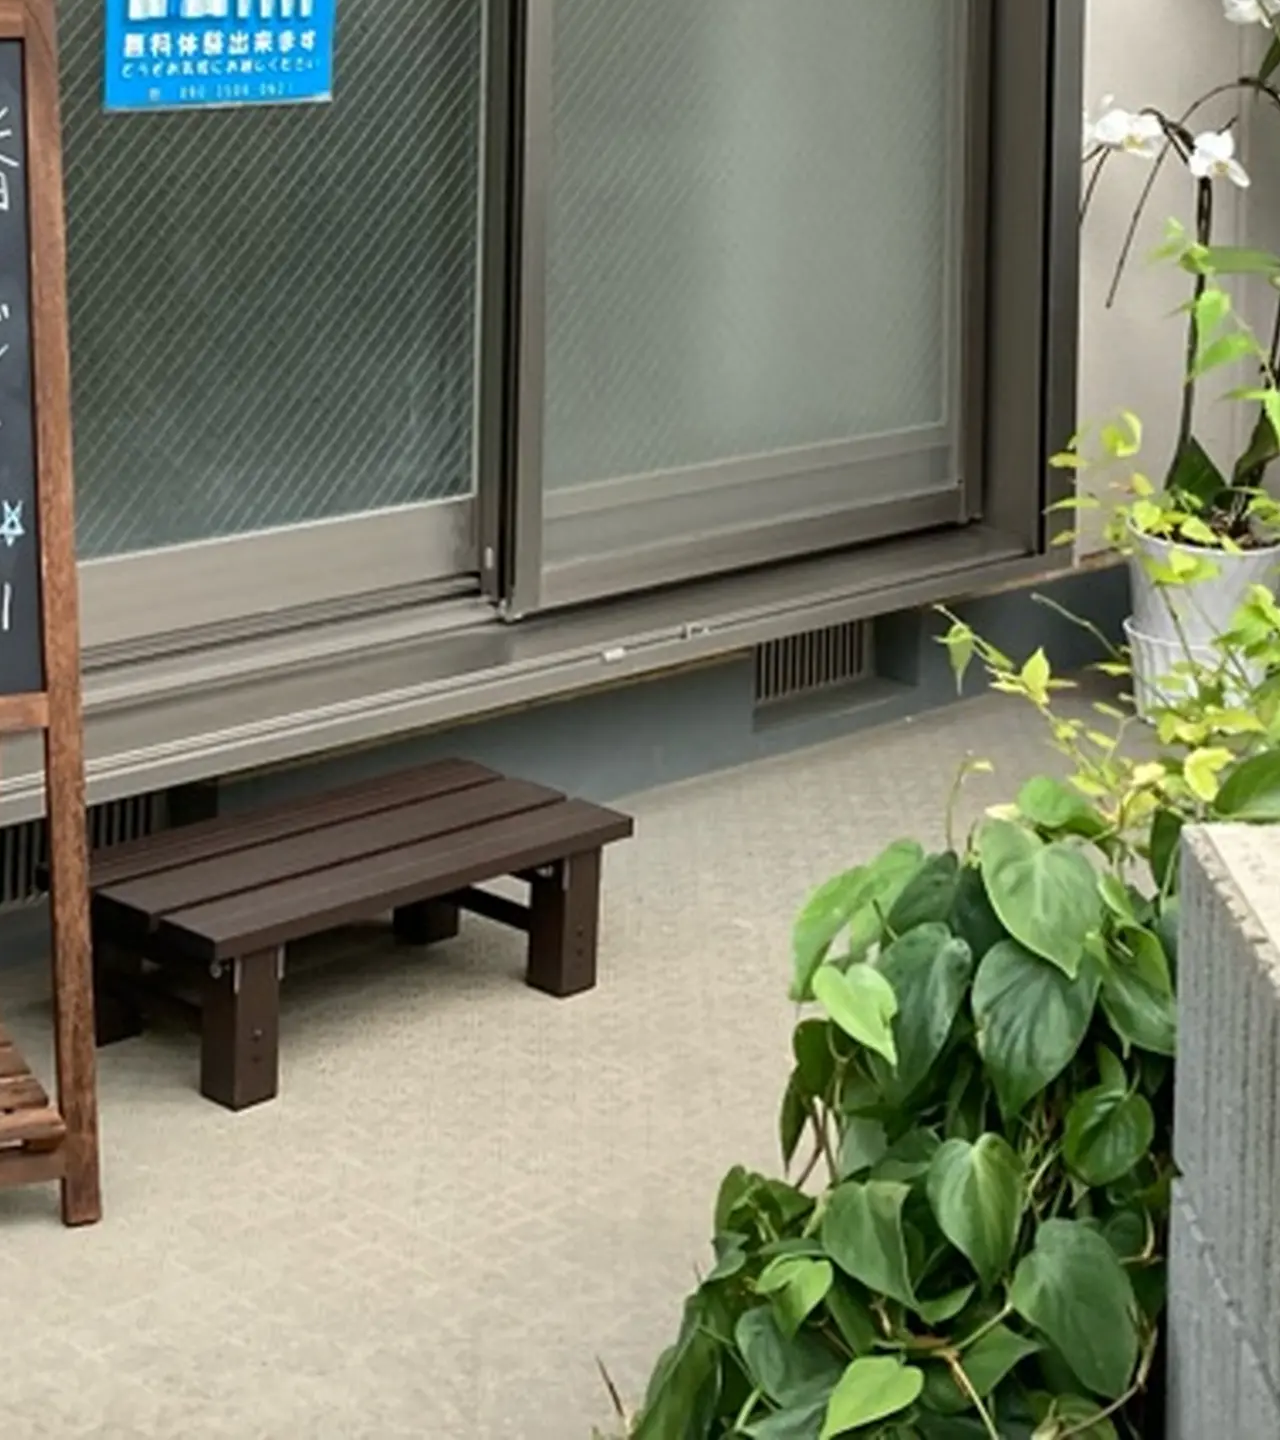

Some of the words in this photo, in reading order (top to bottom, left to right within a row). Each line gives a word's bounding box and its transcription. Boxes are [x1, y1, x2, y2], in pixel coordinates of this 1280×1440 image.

[122, 29, 317, 58] 無料体験出来ます
